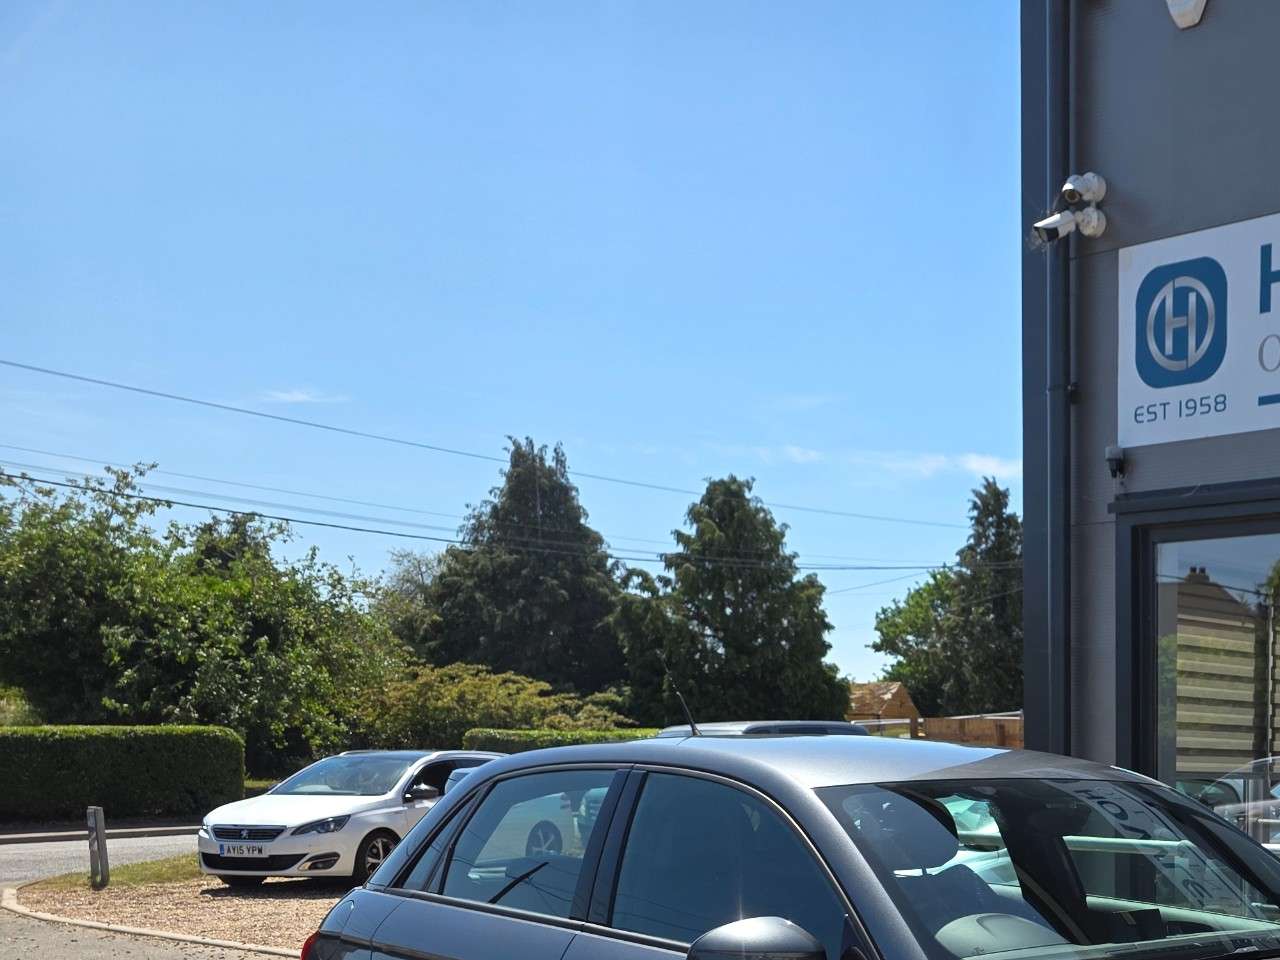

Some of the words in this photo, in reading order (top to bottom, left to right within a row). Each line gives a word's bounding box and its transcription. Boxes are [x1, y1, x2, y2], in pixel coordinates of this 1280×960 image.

[1133, 401, 1171, 425] EST
[1178, 393, 1228, 420] 1958
[226, 845, 245, 855] AY15
